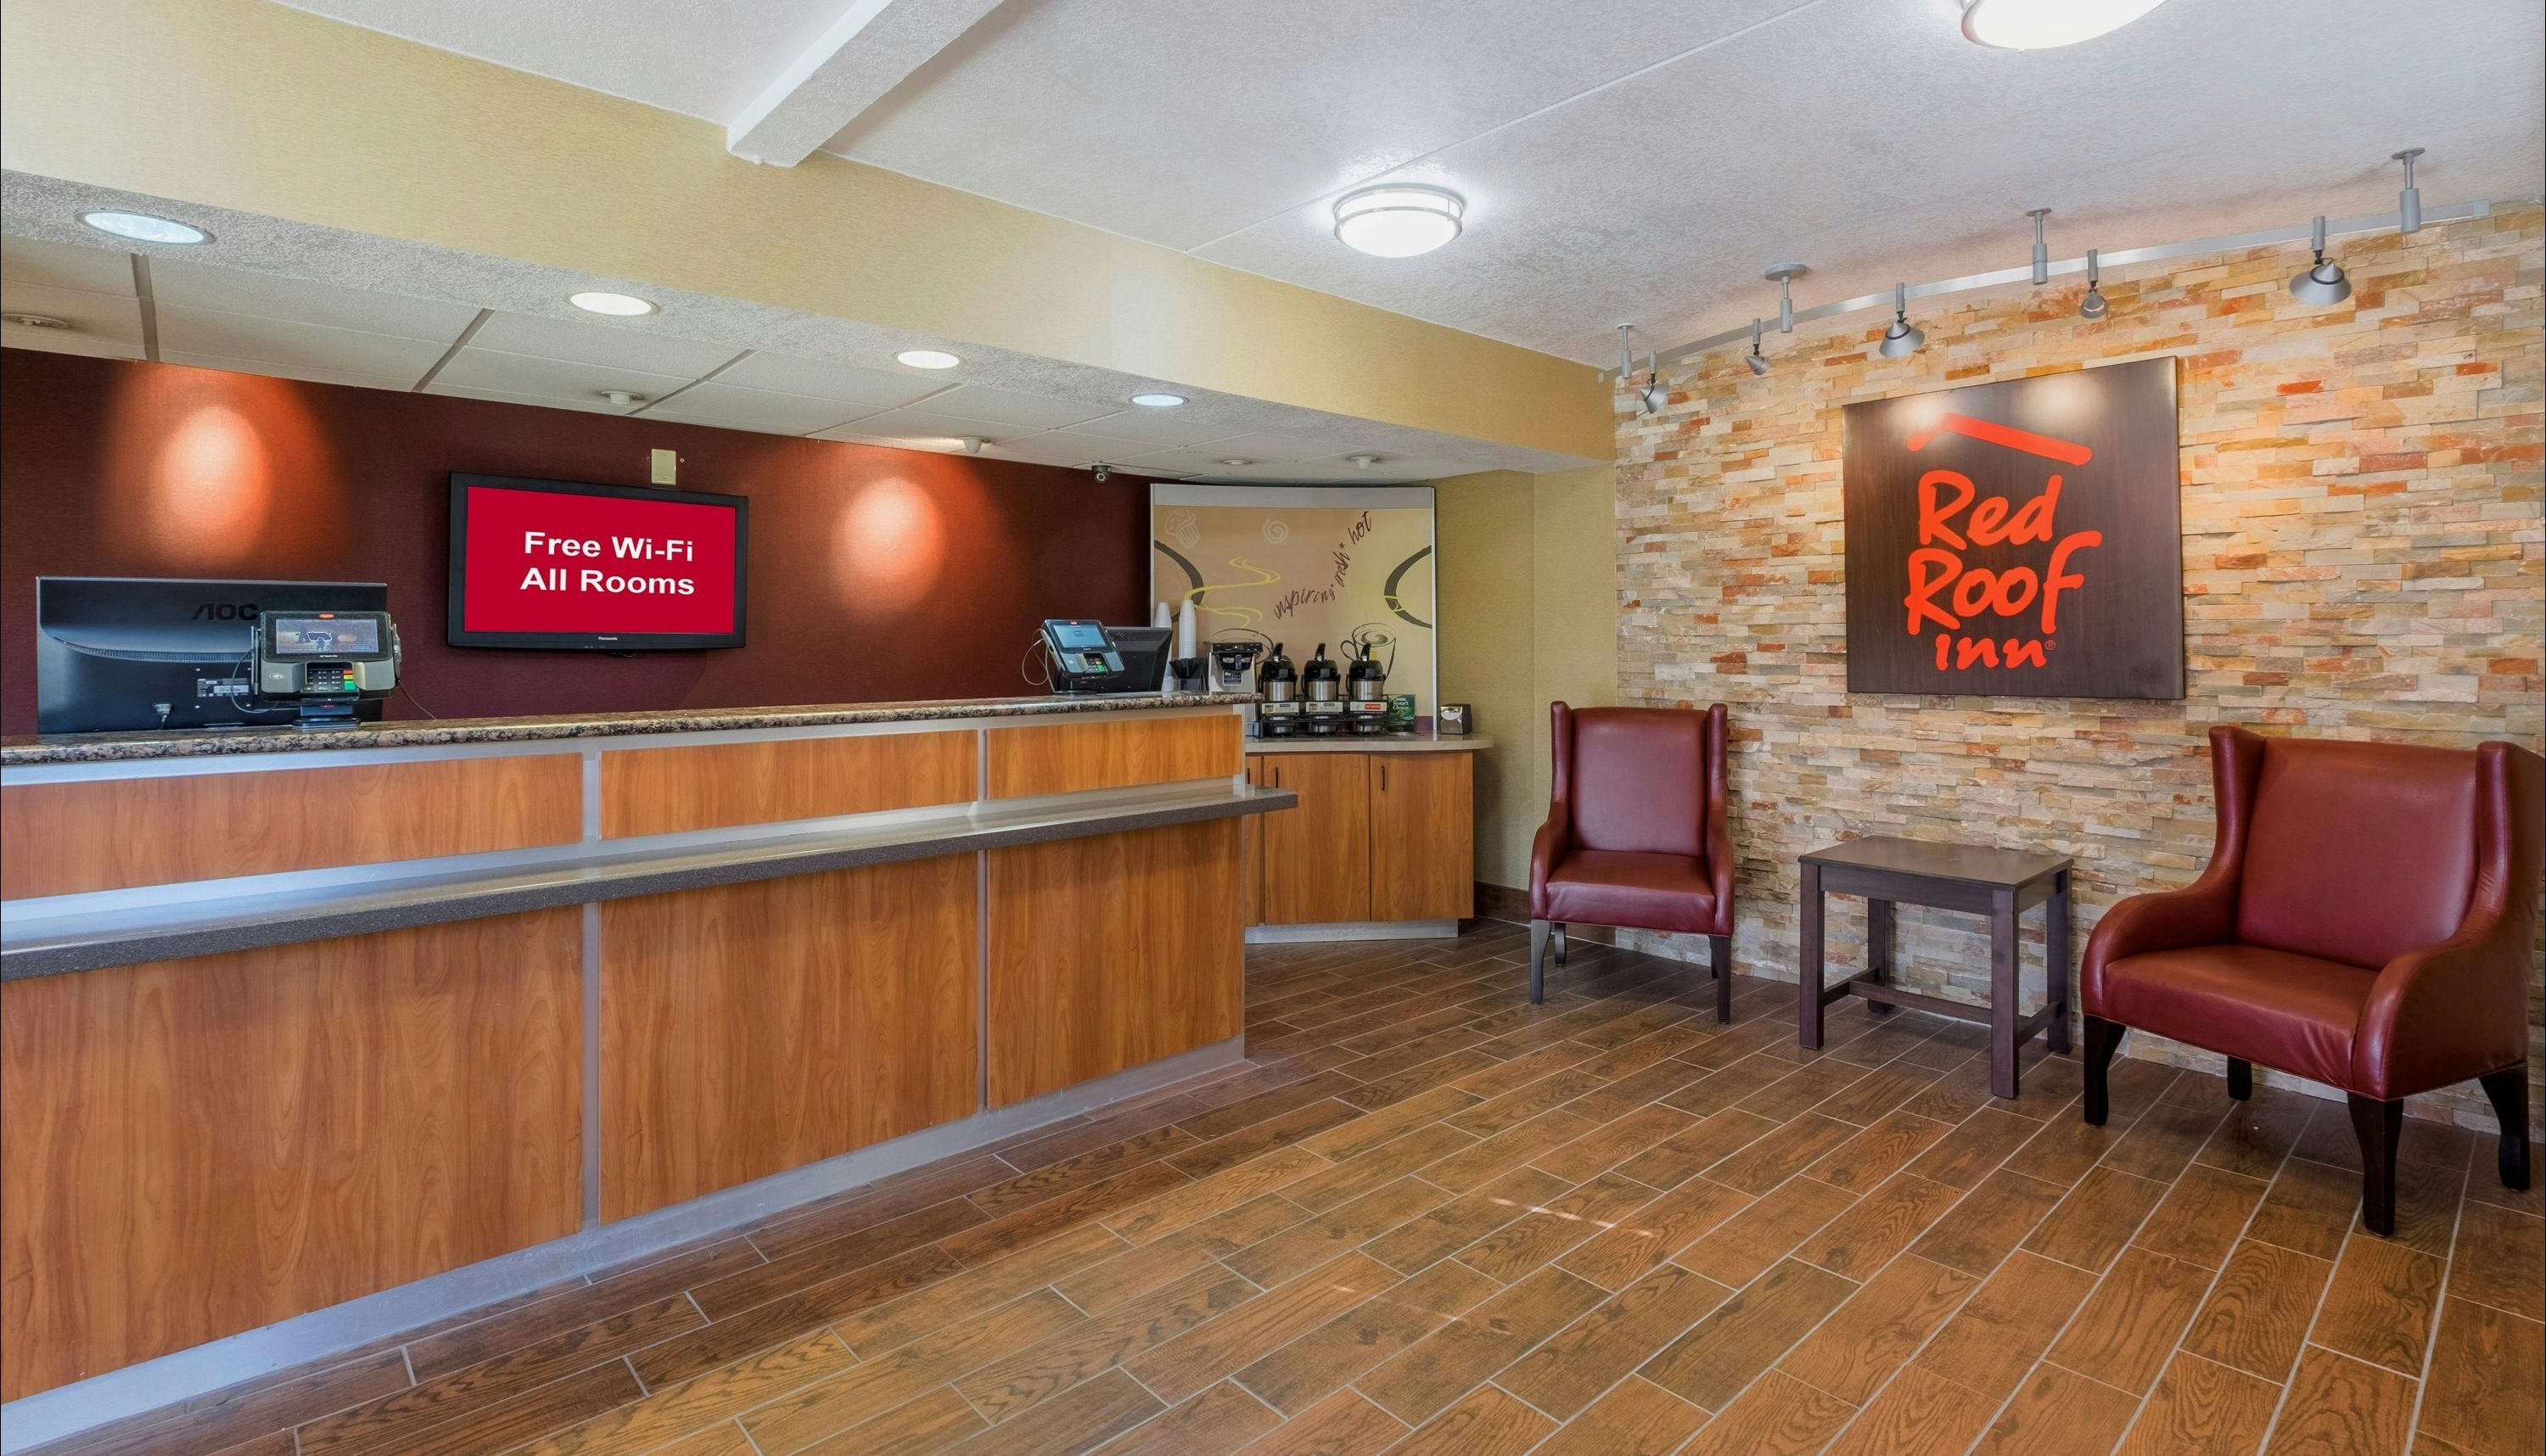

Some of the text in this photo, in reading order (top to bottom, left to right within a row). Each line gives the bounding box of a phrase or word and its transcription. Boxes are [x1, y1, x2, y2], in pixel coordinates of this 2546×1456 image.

[1918, 469, 2062, 551] Red
[524, 531, 694, 562] Free Wi-Fi
[1274, 587, 1336, 619] inspiring
[1347, 510, 1371, 545] hot
[519, 568, 695, 595] All Rooms
[1904, 530, 2102, 636] Roof
[191, 603, 258, 620] AOC
